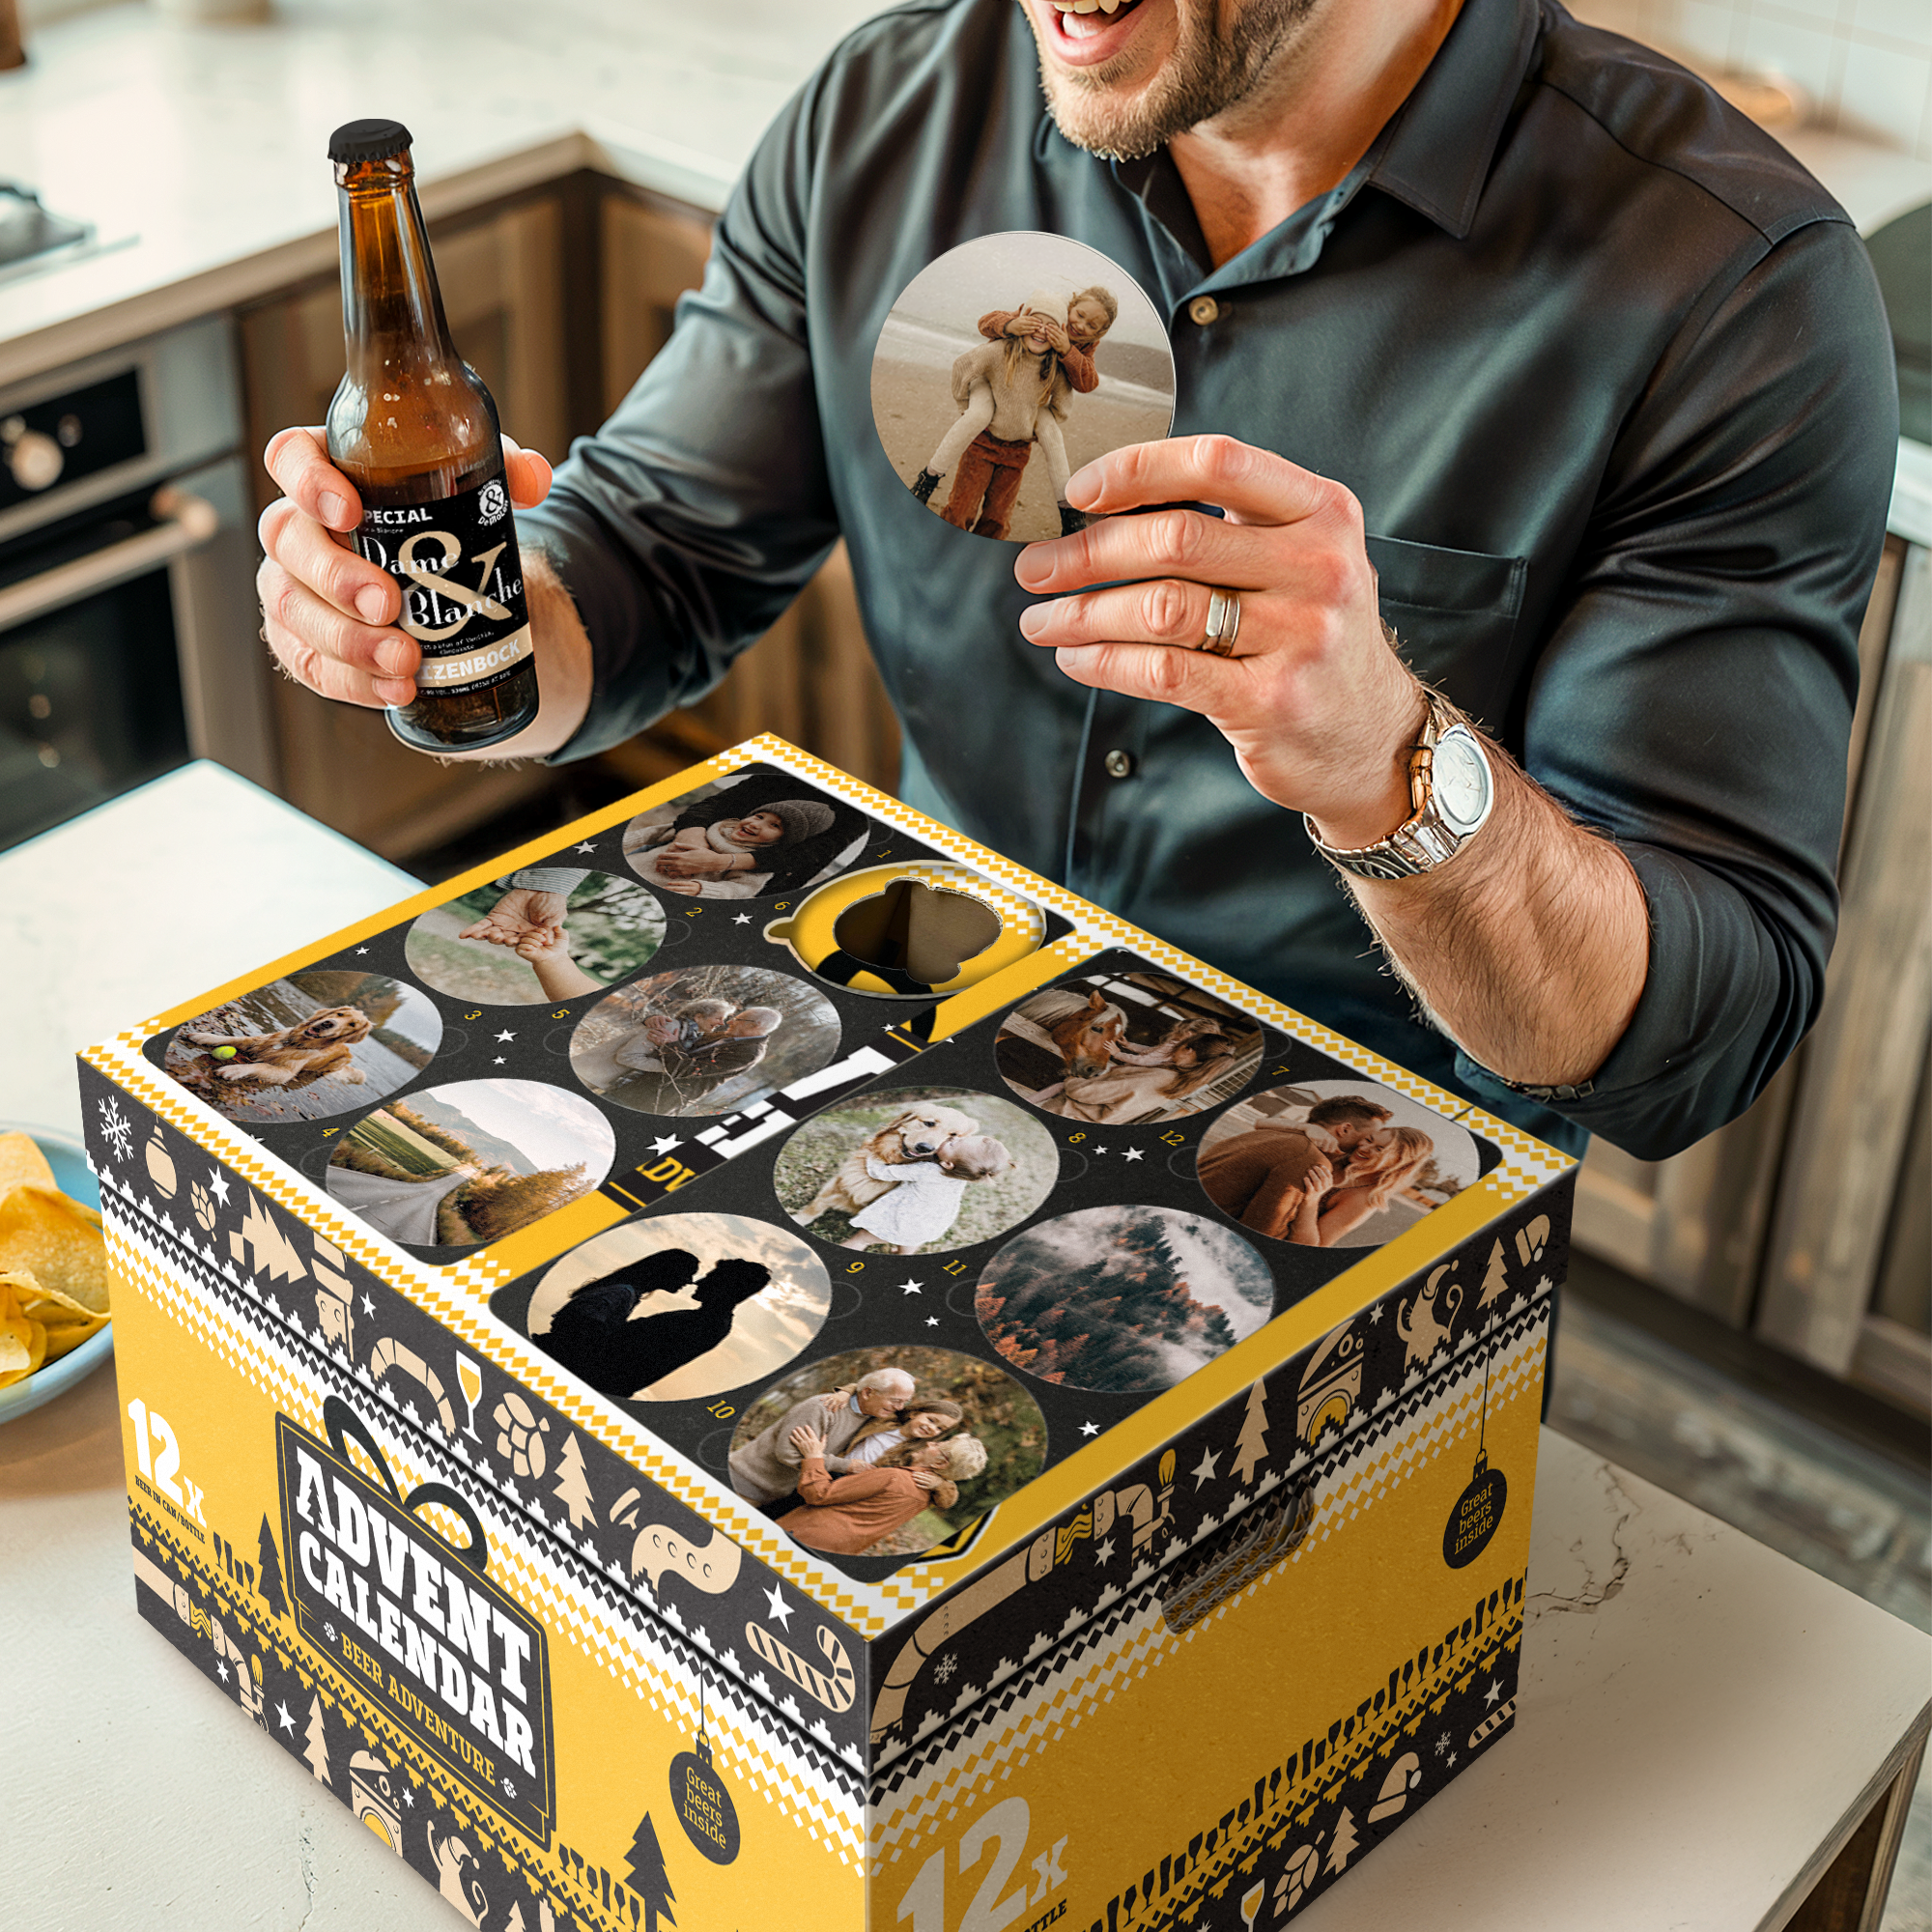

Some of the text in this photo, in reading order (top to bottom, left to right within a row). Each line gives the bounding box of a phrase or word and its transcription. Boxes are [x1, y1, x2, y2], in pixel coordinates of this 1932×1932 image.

[364, 507, 434, 525] PECIAL
[361, 536, 459, 575] Dame
[402, 567, 523, 627] Blanche
[416, 639, 521, 681] IZENBOCK
[685, 907, 703, 918] 2
[774, 901, 791, 911] 6
[464, 1009, 482, 1021] 3
[552, 1009, 571, 1019] 5
[1271, 1065, 1291, 1076] 7
[322, 1127, 341, 1138] 4
[1068, 1132, 1087, 1144] 8
[1159, 1129, 1185, 1147] 12
[845, 1262, 866, 1274] 9
[942, 1260, 968, 1277] 11
[706, 1400, 736, 1419] 10
[135, 1474, 153, 1498] BEER
[1461, 1481, 1493, 1517] Great
[1459, 1500, 1492, 1535] beers
[1454, 1515, 1493, 1555] inside
[296, 1445, 531, 1705] ADVENT
[298, 1530, 536, 1778] CALENDAR
[341, 1632, 497, 1786] BEER ADVENTURE
[686, 1766, 723, 1809] Great
[685, 1782, 723, 1828] beers
[683, 1800, 726, 1850] inside
[1024, 1897, 1067, 1932] TTLE
